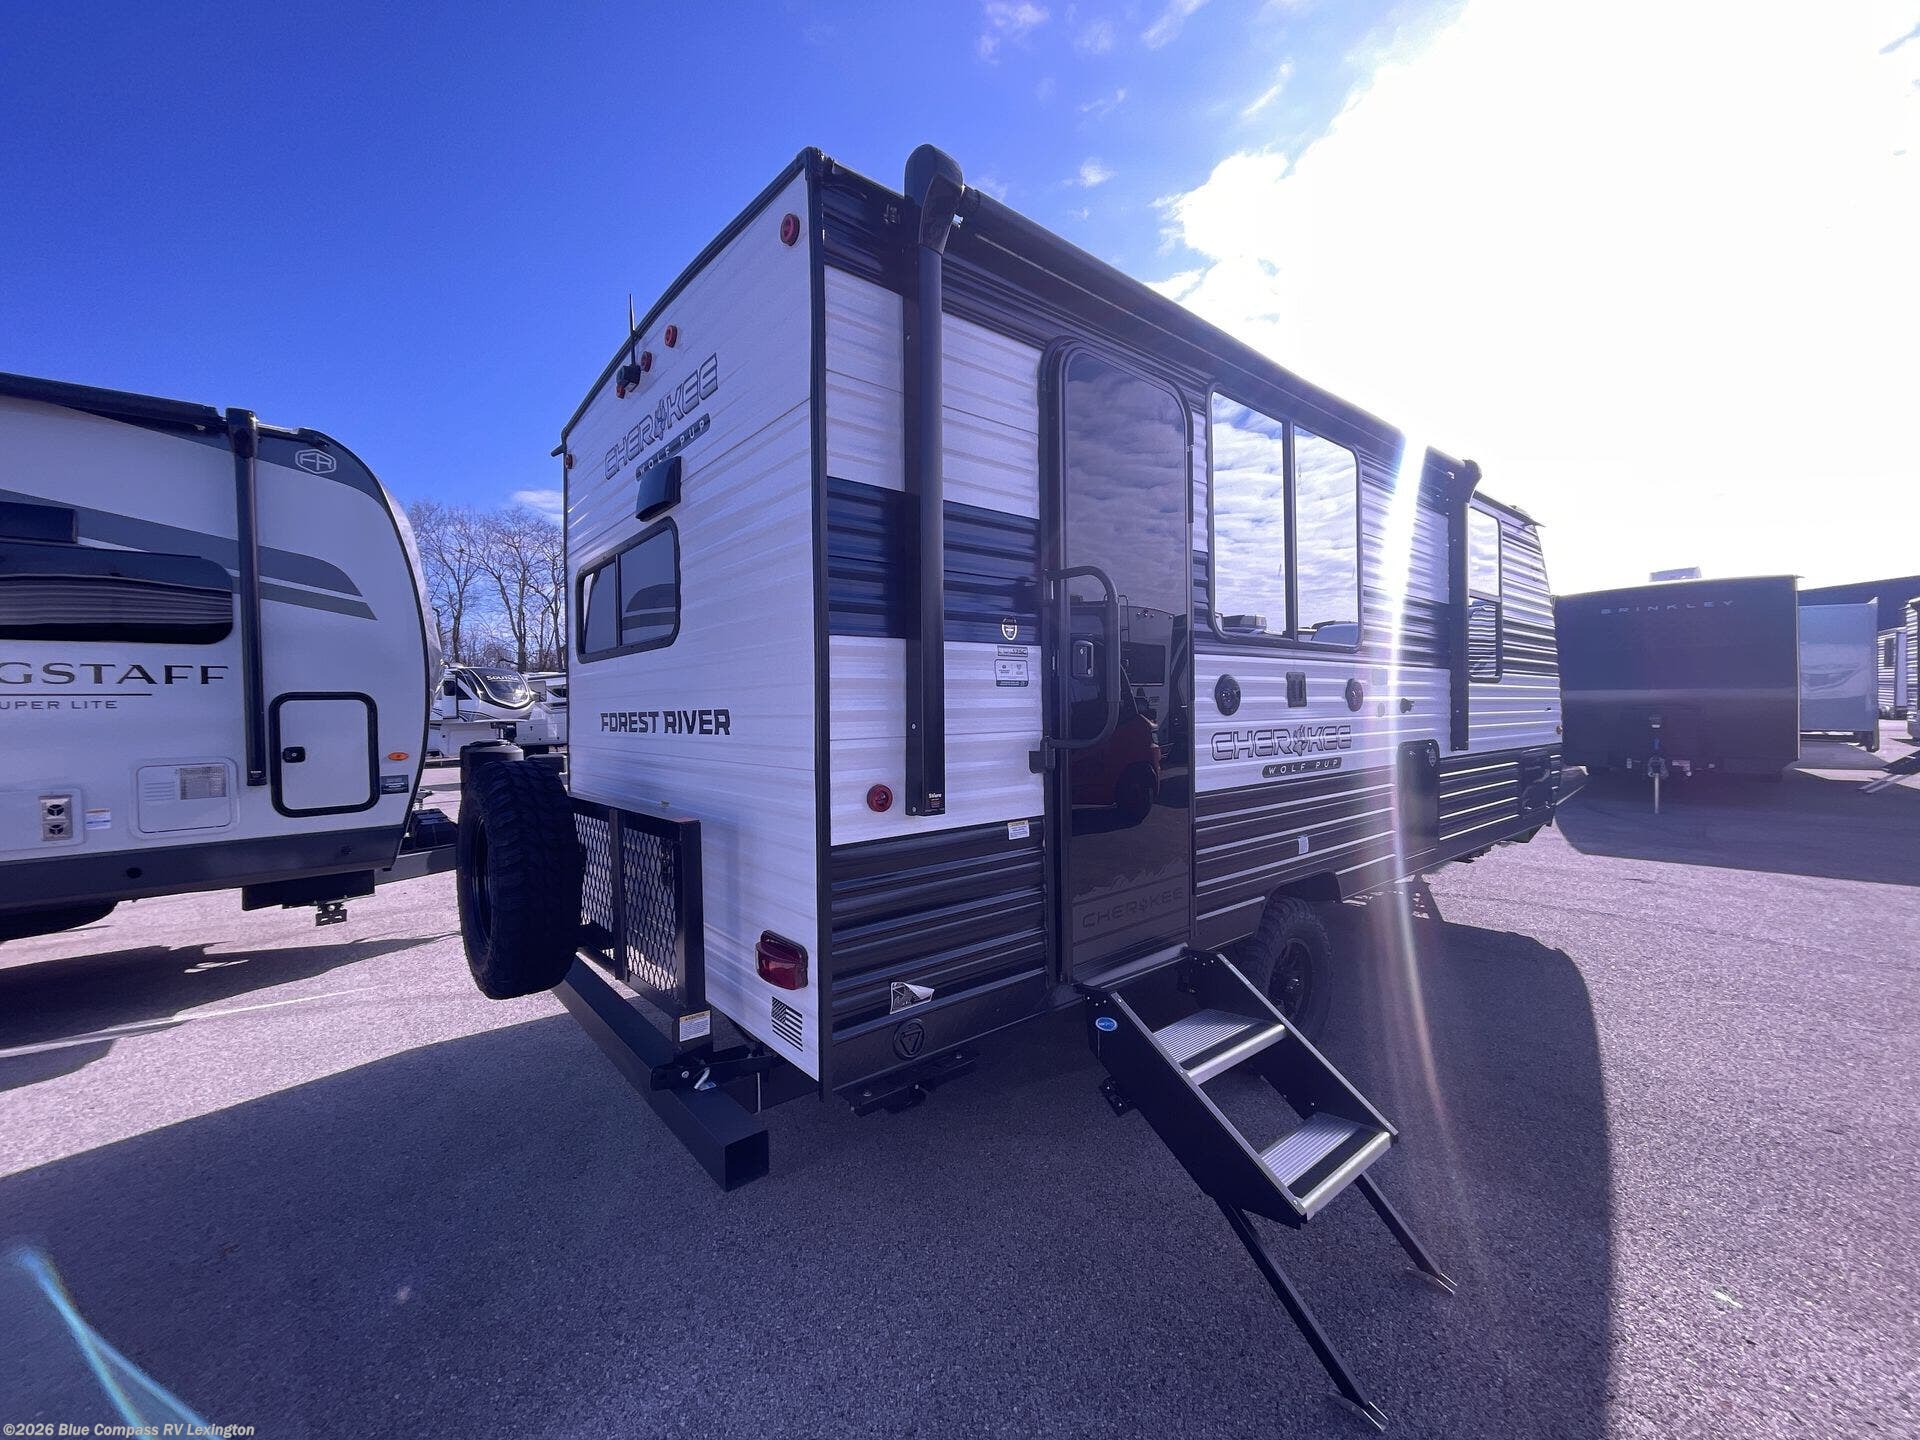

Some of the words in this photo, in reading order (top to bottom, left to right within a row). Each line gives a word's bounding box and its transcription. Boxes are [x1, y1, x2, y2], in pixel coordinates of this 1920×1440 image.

[605, 352, 718, 480] CHEROKEE
[639, 446, 670, 475] WOLF
[680, 420, 705, 446] PUP
[1601, 600, 1733, 614] BRINKLEY
[71, 700, 118, 709] LITE
[601, 712, 659, 733] FOREST
[663, 709, 730, 735] RIVER
[1211, 724, 1352, 761] CHEROKEE
[1268, 762, 1306, 774] WOLF
[1315, 759, 1339, 769] PUP
